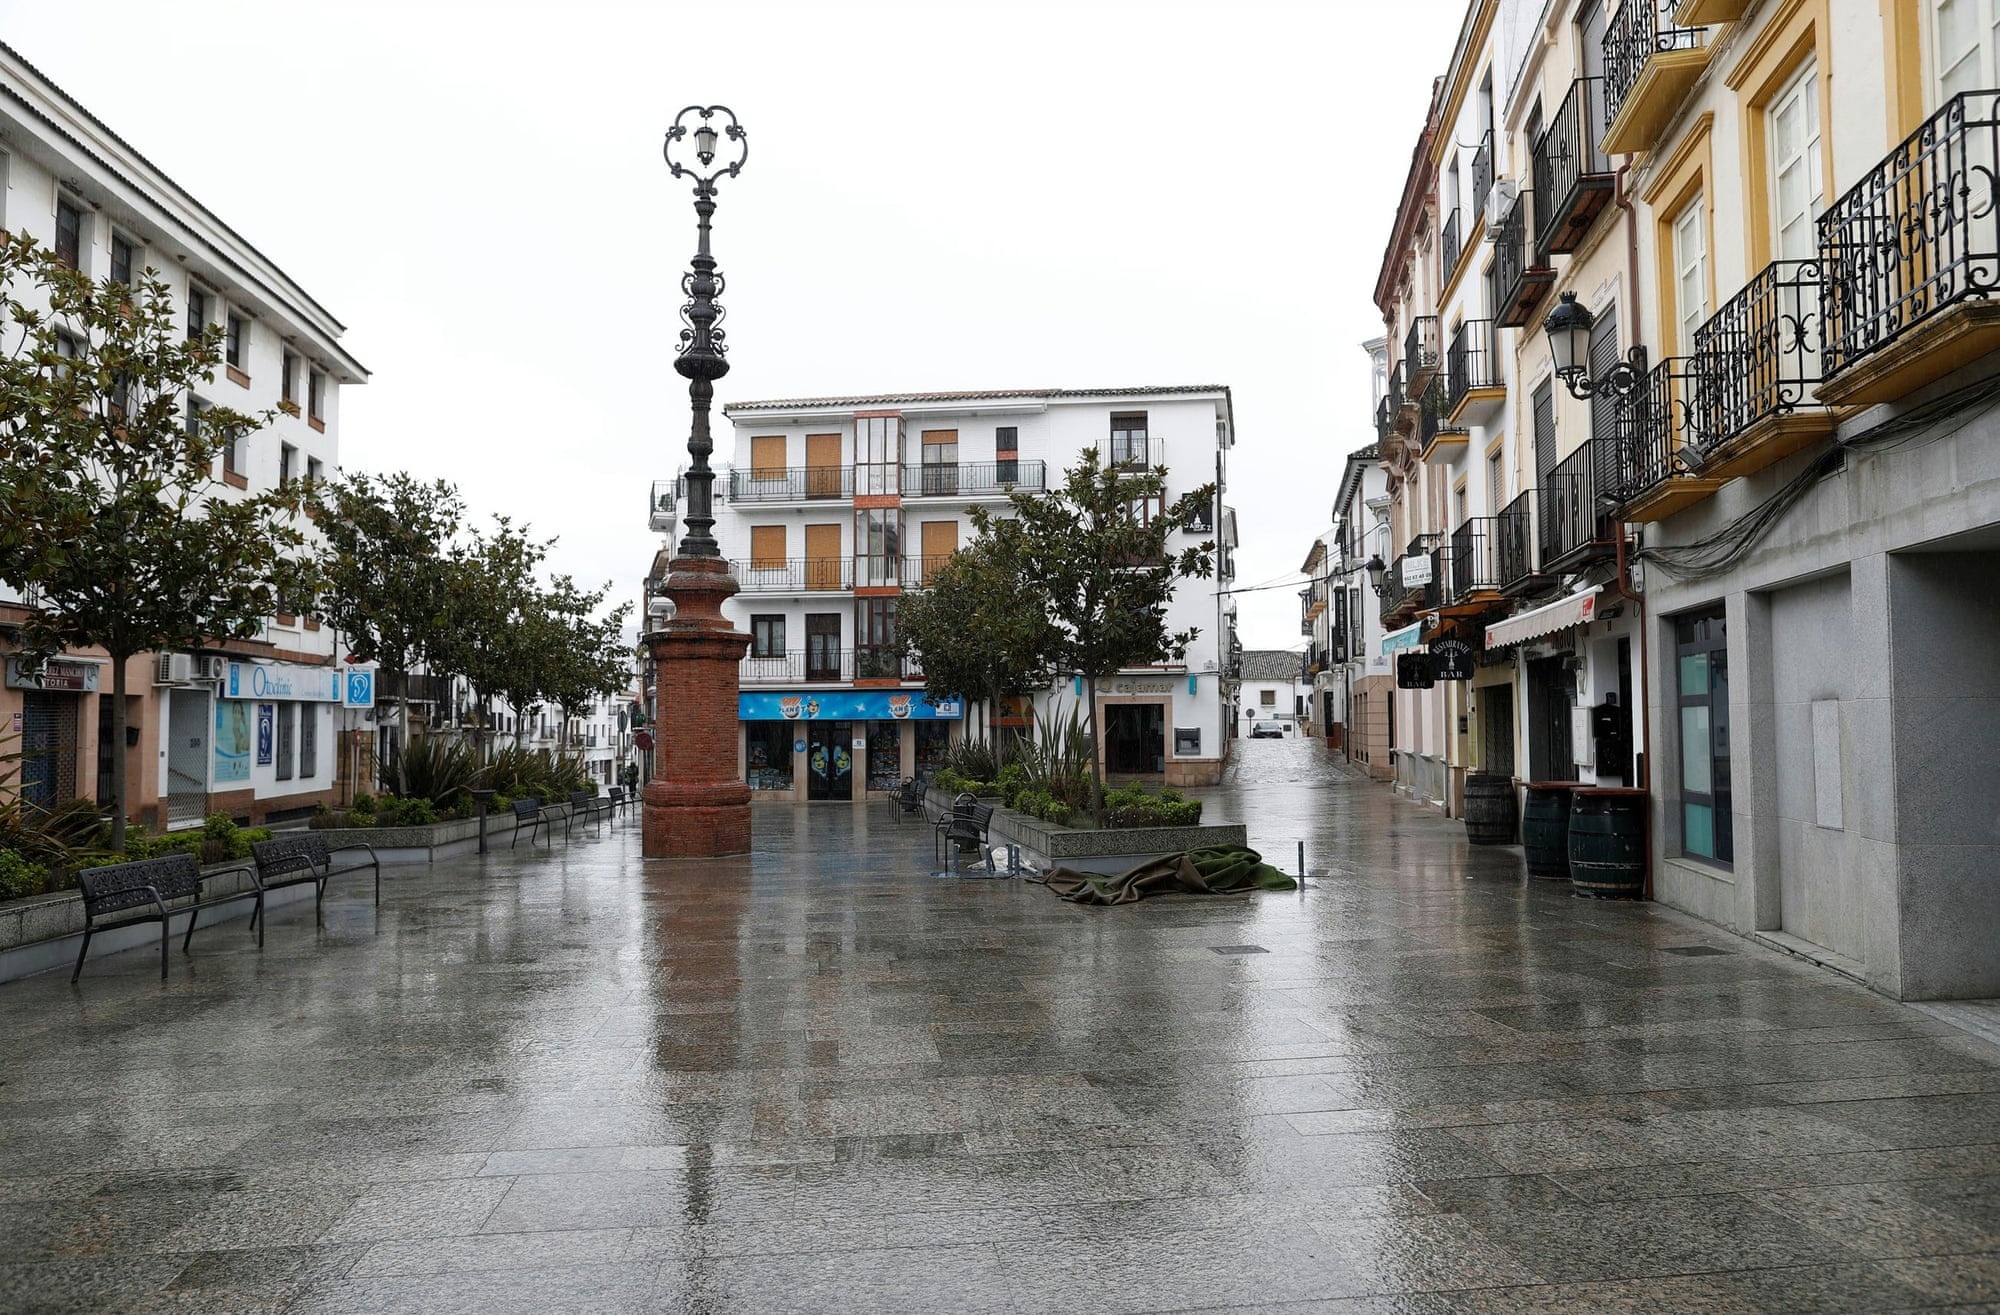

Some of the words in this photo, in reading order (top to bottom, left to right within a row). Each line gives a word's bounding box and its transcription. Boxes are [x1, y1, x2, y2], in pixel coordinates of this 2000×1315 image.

[1432, 639, 1471, 655] RESTAURANTE
[1440, 671, 1464, 679] BAR
[1116, 681, 1174, 696] cajamar
